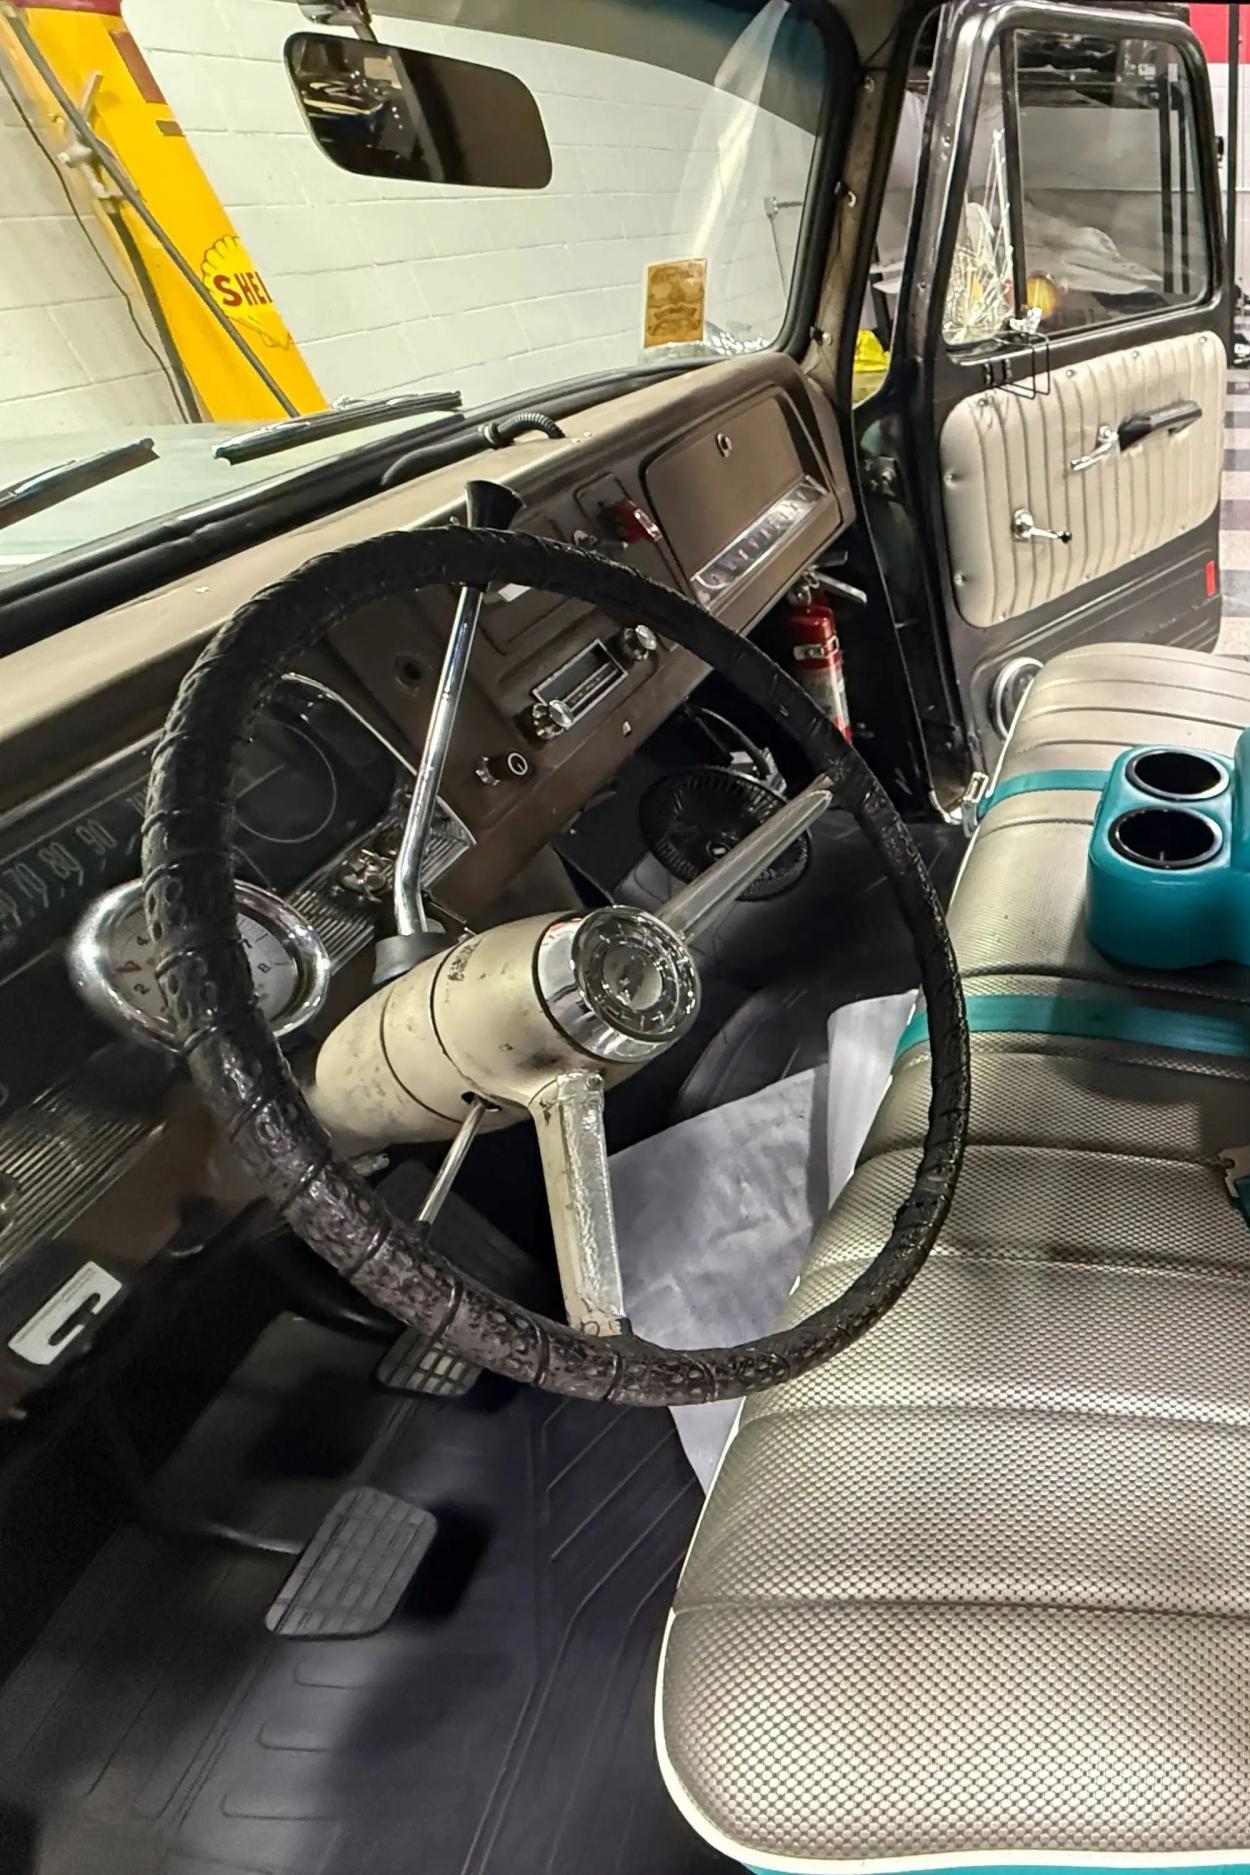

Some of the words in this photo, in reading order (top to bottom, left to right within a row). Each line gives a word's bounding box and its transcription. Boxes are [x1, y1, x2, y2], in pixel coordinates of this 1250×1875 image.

[1, 863, 46, 899] 70
[38, 842, 80, 879] 80
[75, 818, 117, 855] 90
